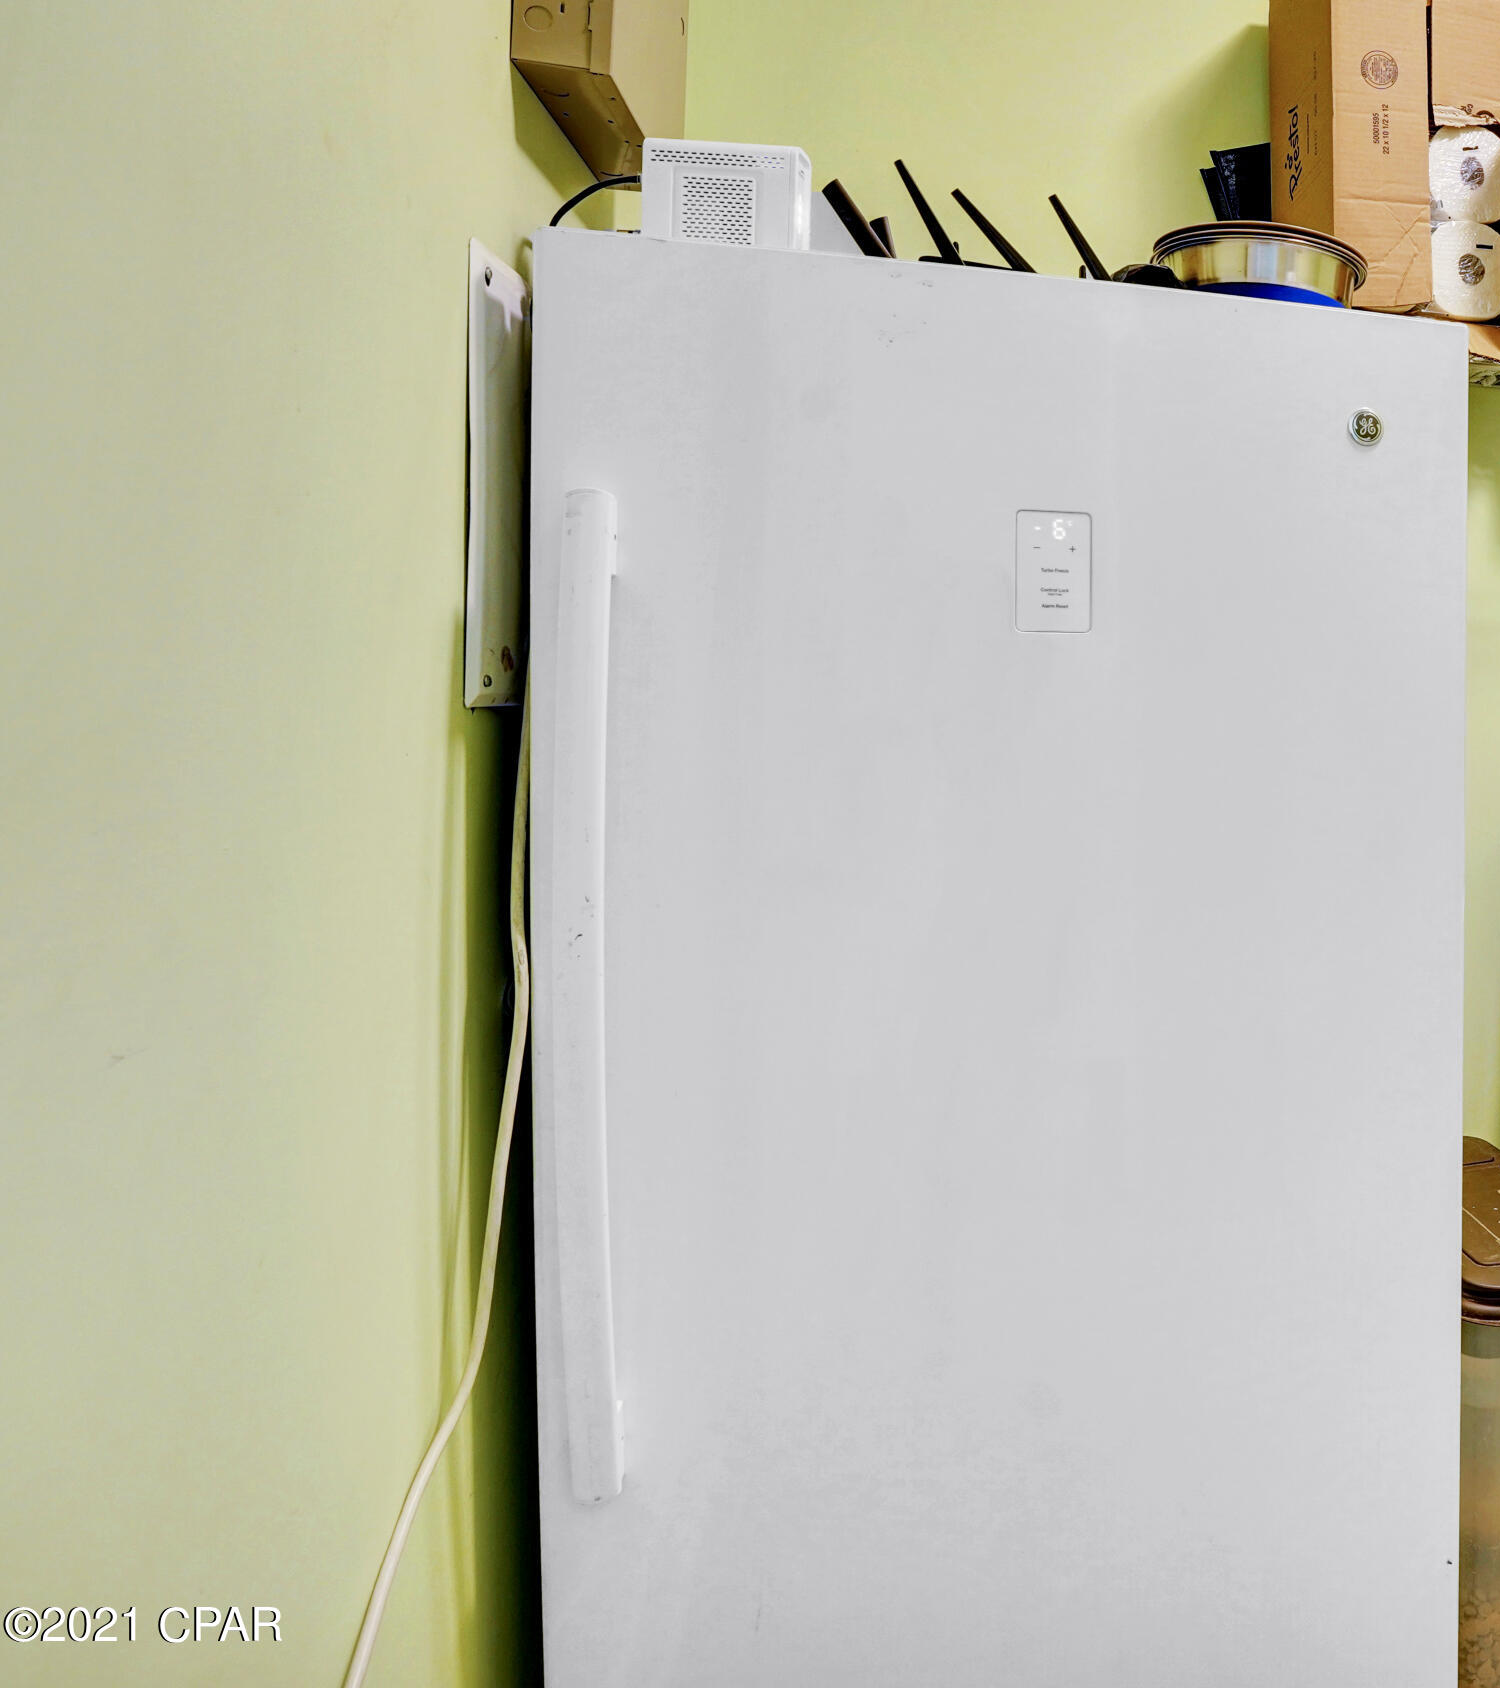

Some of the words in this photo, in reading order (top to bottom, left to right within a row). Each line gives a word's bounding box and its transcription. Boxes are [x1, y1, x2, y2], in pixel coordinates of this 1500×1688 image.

[1381, 103, 1388, 112] 12
[1372, 112, 1380, 144] 50001595
[1382, 130, 1389, 139] 10
[1382, 145, 1389, 155] 22
